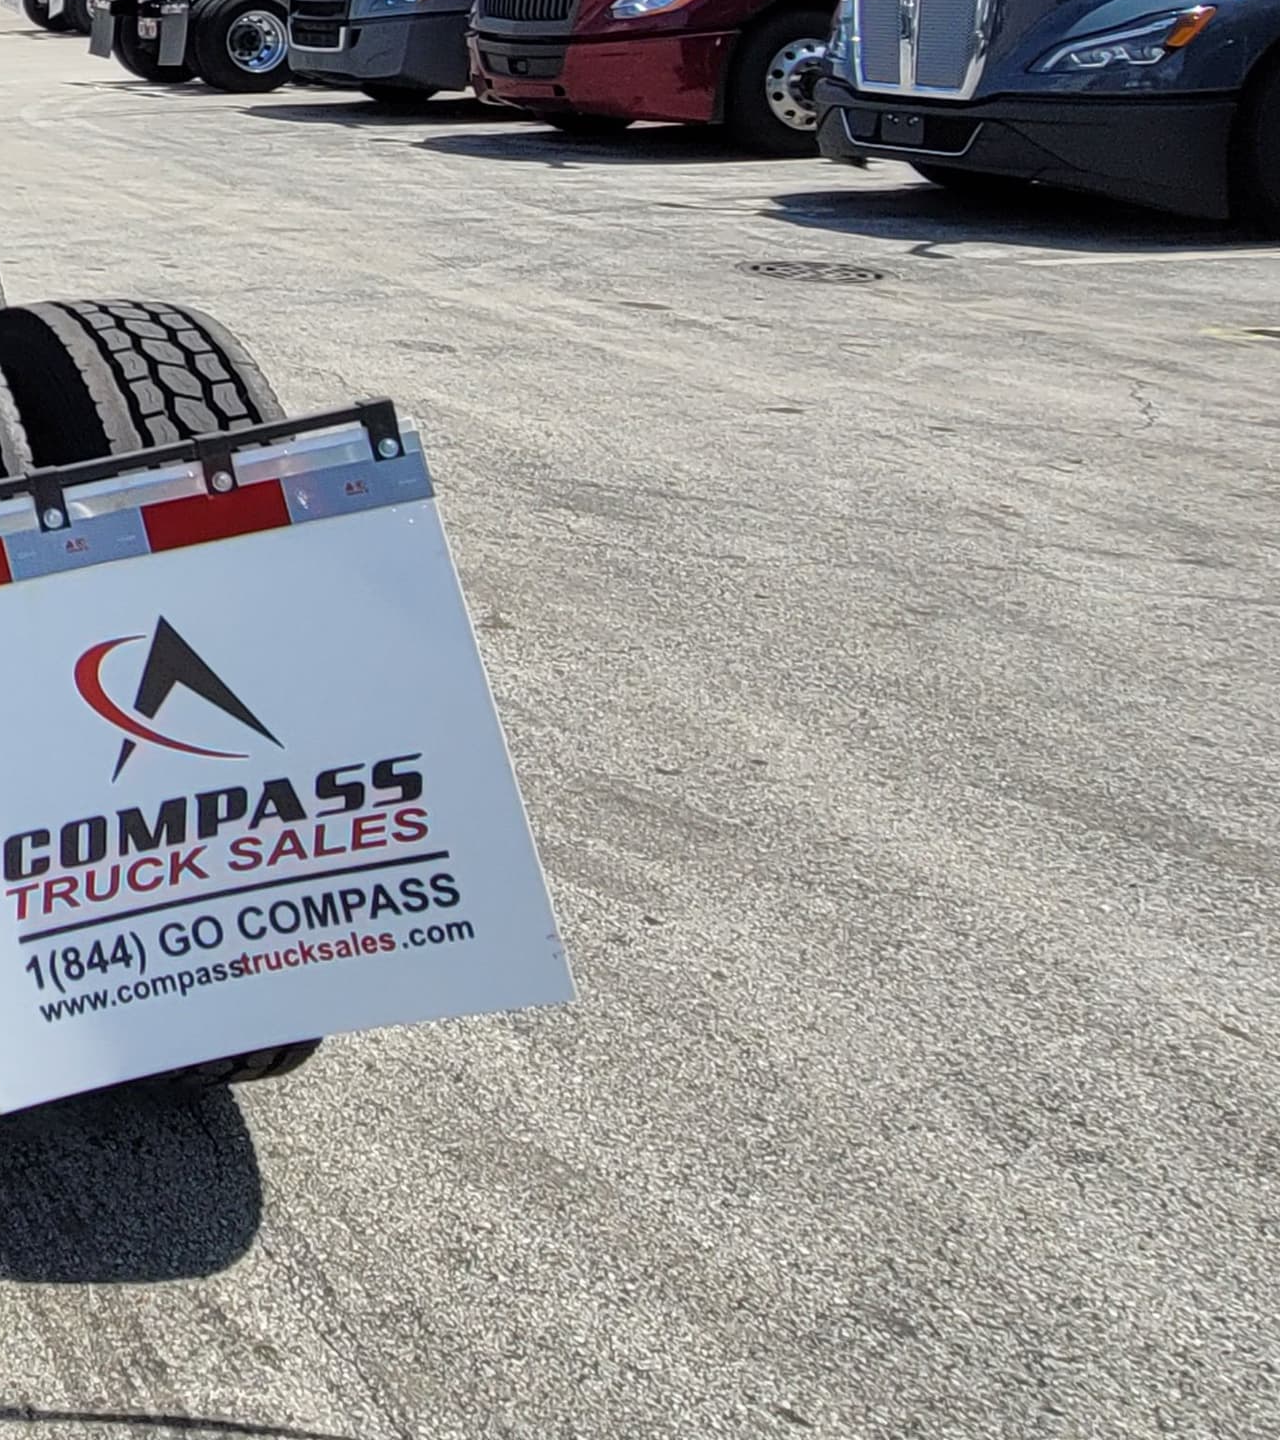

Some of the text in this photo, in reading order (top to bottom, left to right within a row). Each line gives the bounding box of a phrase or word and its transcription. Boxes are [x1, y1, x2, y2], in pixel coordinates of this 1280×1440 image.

[3, 753, 424, 882] COMPASS
[6, 807, 429, 921] TRUCK SALES
[26, 873, 461, 991] 1(844) GO COMPASS
